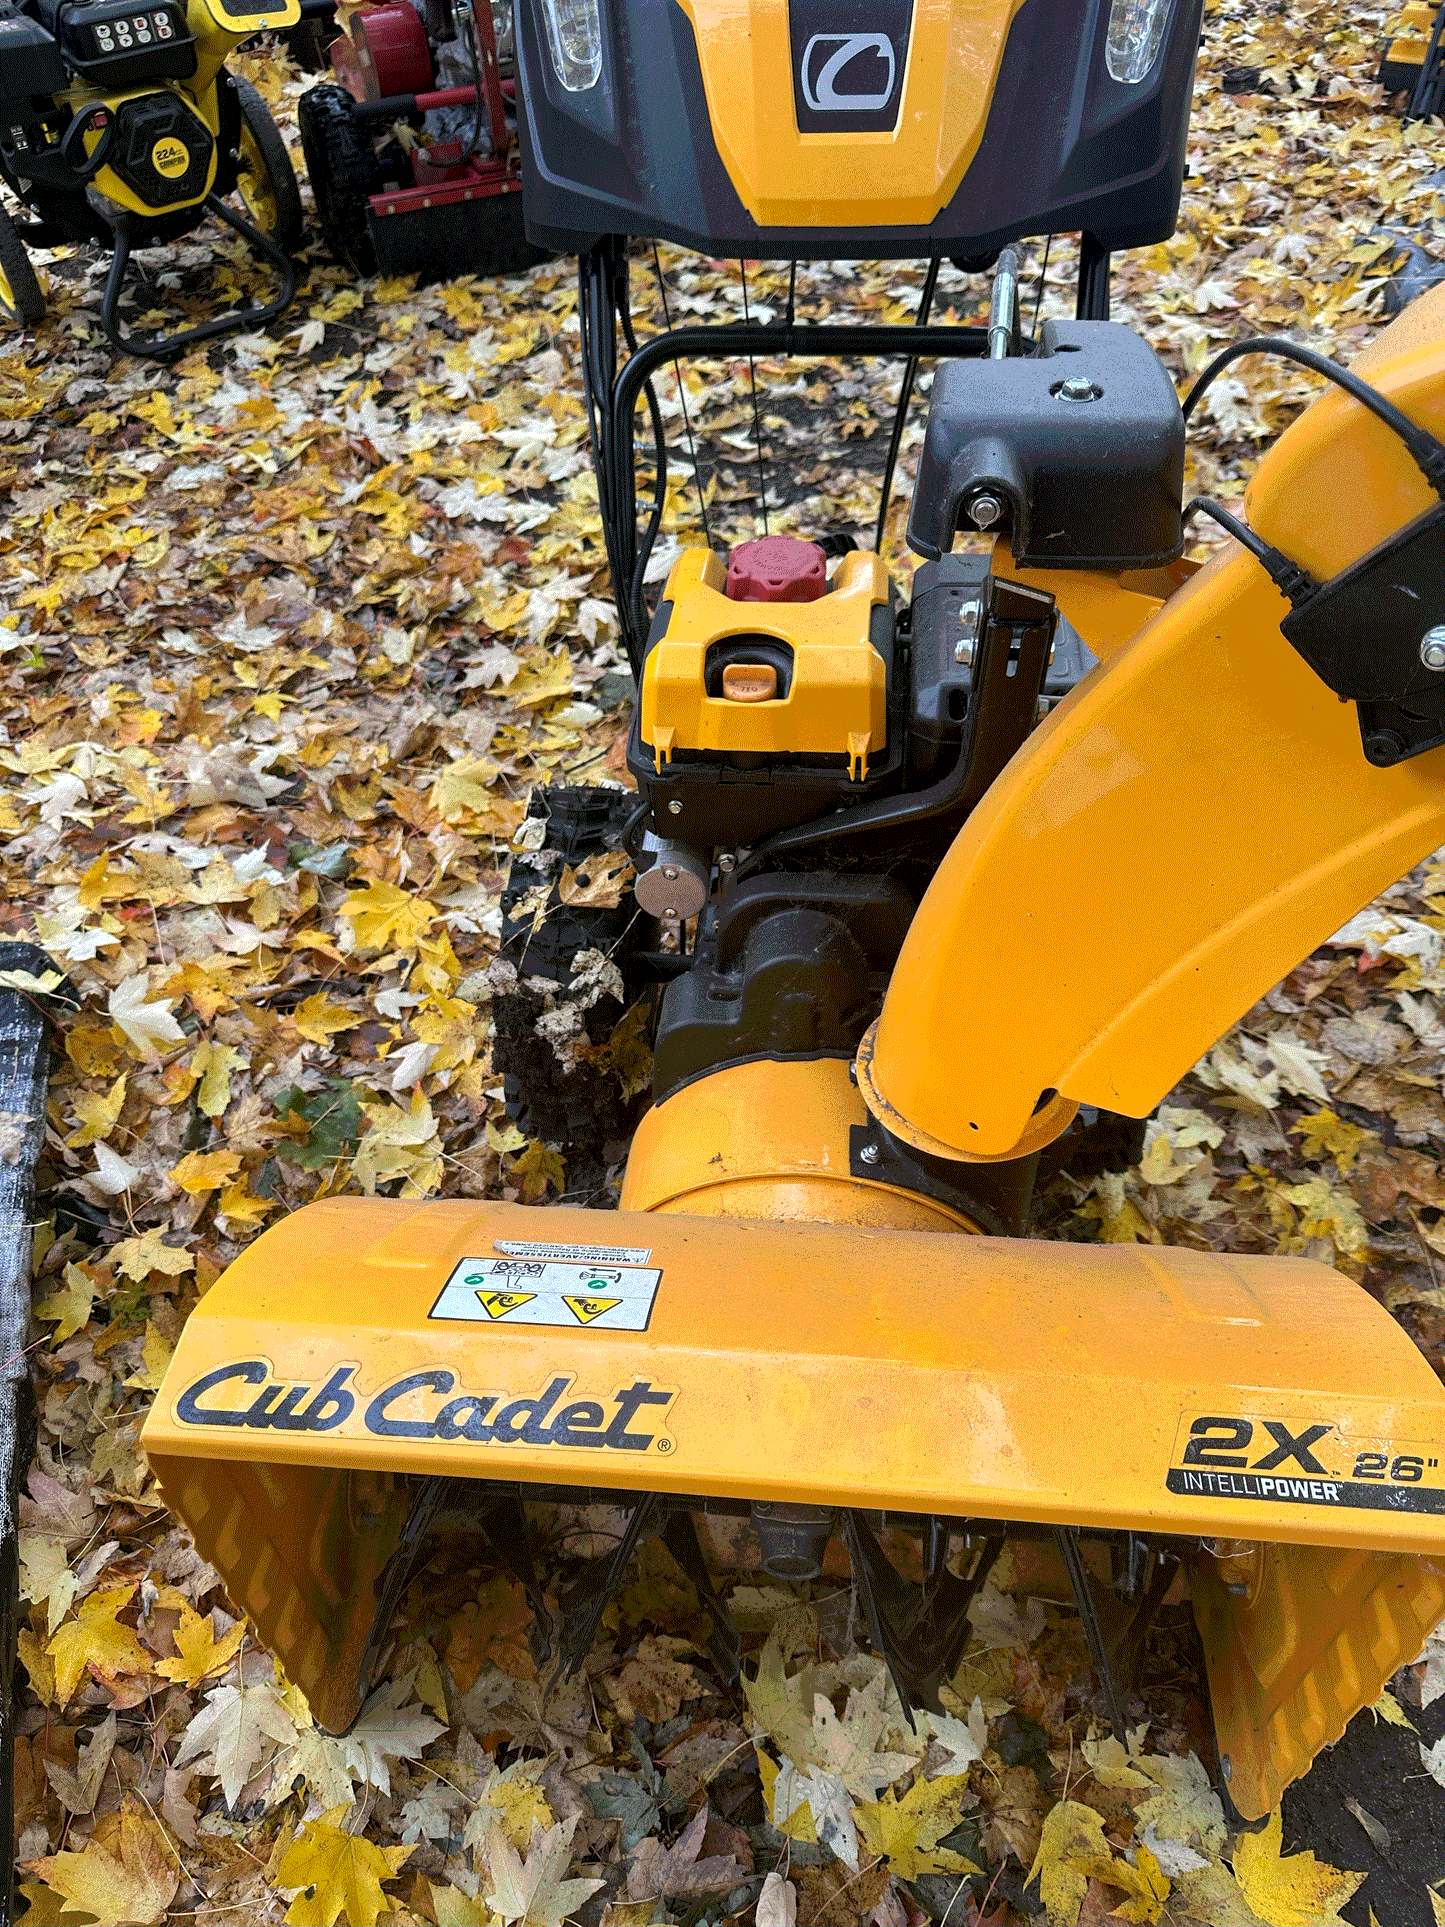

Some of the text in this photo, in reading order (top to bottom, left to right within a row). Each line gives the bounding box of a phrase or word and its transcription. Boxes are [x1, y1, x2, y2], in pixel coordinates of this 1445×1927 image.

[156, 147, 175, 160] 224
[177, 1361, 674, 1451] Cub Cadet
[1183, 1416, 1438, 1482] 2X 26"
